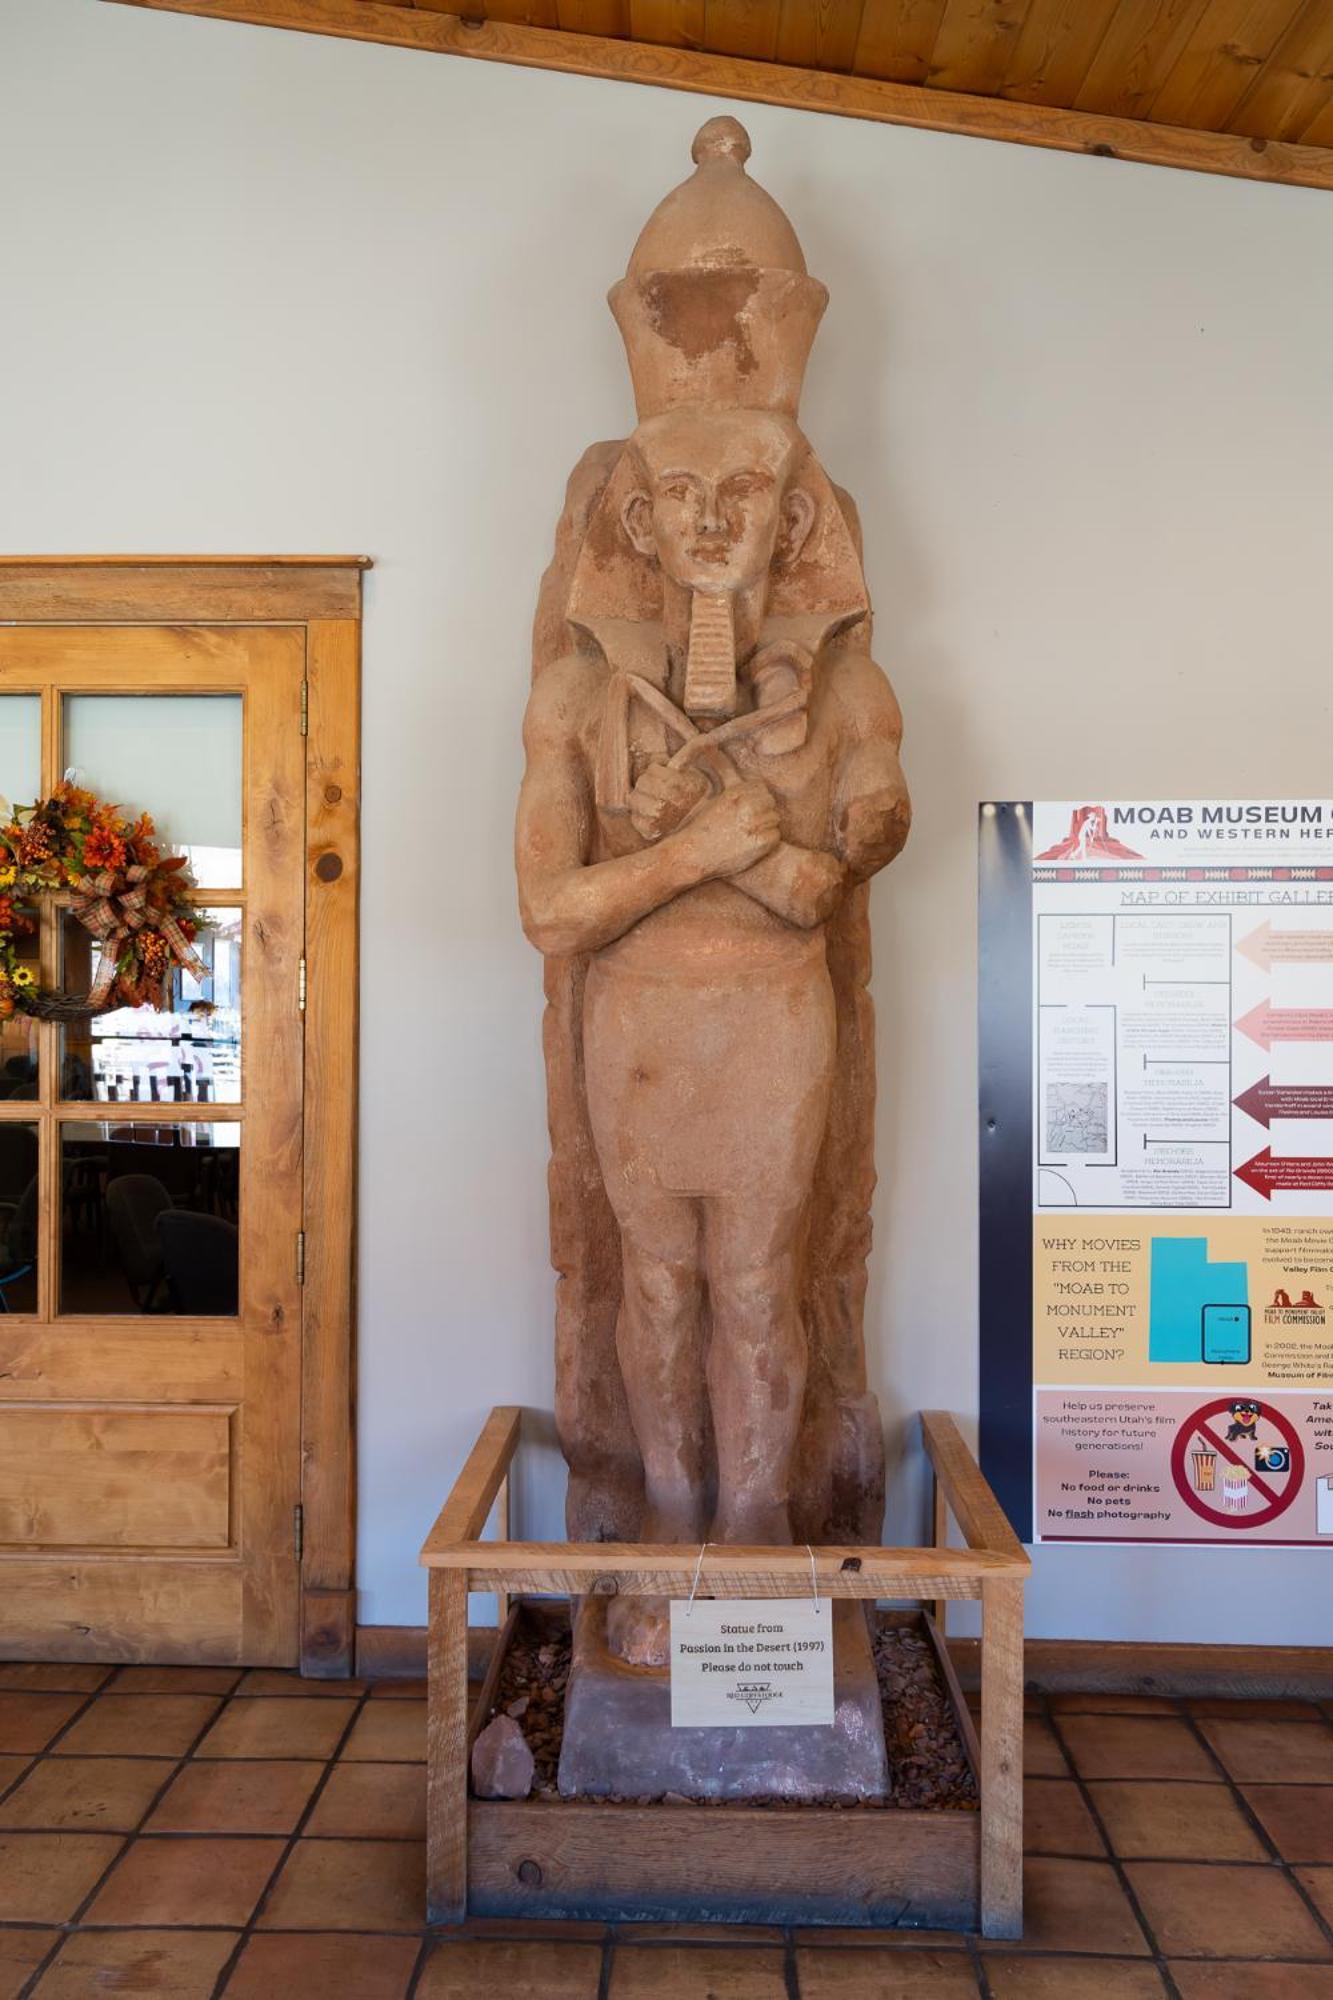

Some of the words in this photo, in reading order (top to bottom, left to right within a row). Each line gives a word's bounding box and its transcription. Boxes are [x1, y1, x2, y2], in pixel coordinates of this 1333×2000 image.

[1114, 807, 1193, 824] MOAB
[1201, 806, 1322, 824] MUSEUM
[1150, 829, 1188, 839] AND
[1199, 829, 1290, 839] WESTERN
[1121, 890, 1160, 905] MAP
[1164, 890, 1188, 905] OF
[1196, 890, 1264, 905] EXHIBIT
[1042, 1238, 1077, 1250] WHY
[1081, 1238, 1141, 1251] MOVIES
[1052, 1260, 1096, 1272] FROM
[1099, 1261, 1131, 1273] THE
[1283, 1266, 1308, 1274] Valley
[1053, 1282, 1104, 1295] "MOAB
[1107, 1283, 1130, 1295] TO
[1047, 1305, 1136, 1317] MONUMENT
[1264, 1314, 1281, 1324] FILM
[1282, 1314, 1326, 1325] COMMISSION
[1057, 1326, 1125, 1338] VALLEY"
[1058, 1348, 1125, 1361] REGION?
[1062, 1401, 1087, 1411] Help
[1089, 1403, 1103, 1411] us
[1105, 1403, 1155, 1412] preserve
[1043, 1414, 1118, 1424] southeastern
[1119, 1415, 1152, 1424] Utah's
[1155, 1415, 1176, 1425] film
[1306, 1415, 1333, 1424] Ame
[1061, 1428, 1100, 1438] history
[1102, 1428, 1119, 1437] for
[1121, 1428, 1157, 1438] future
[1075, 1442, 1144, 1451] generations!
[1088, 1469, 1130, 1479] Please:
[1060, 1483, 1076, 1492] No
[1078, 1483, 1106, 1492] food
[1123, 1484, 1160, 1493] drinks
[1087, 1497, 1103, 1505] No
[1105, 1497, 1131, 1506] pets
[1047, 1509, 1063, 1518] No
[1065, 1509, 1094, 1518] flash
[1096, 1510, 1171, 1520] photography
[720, 1624, 755, 1634] Statue
[757, 1623, 784, 1633] from
[680, 1643, 721, 1653] Passion
[724, 1643, 734, 1653] in
[736, 1642, 754, 1653] the
[756, 1641, 791, 1652] Desert
[793, 1641, 825, 1653] (1997)
[701, 1662, 736, 1672] Please
[738, 1662, 751, 1672] do
[754, 1662, 771, 1671] not
[773, 1661, 804, 1671] touch
